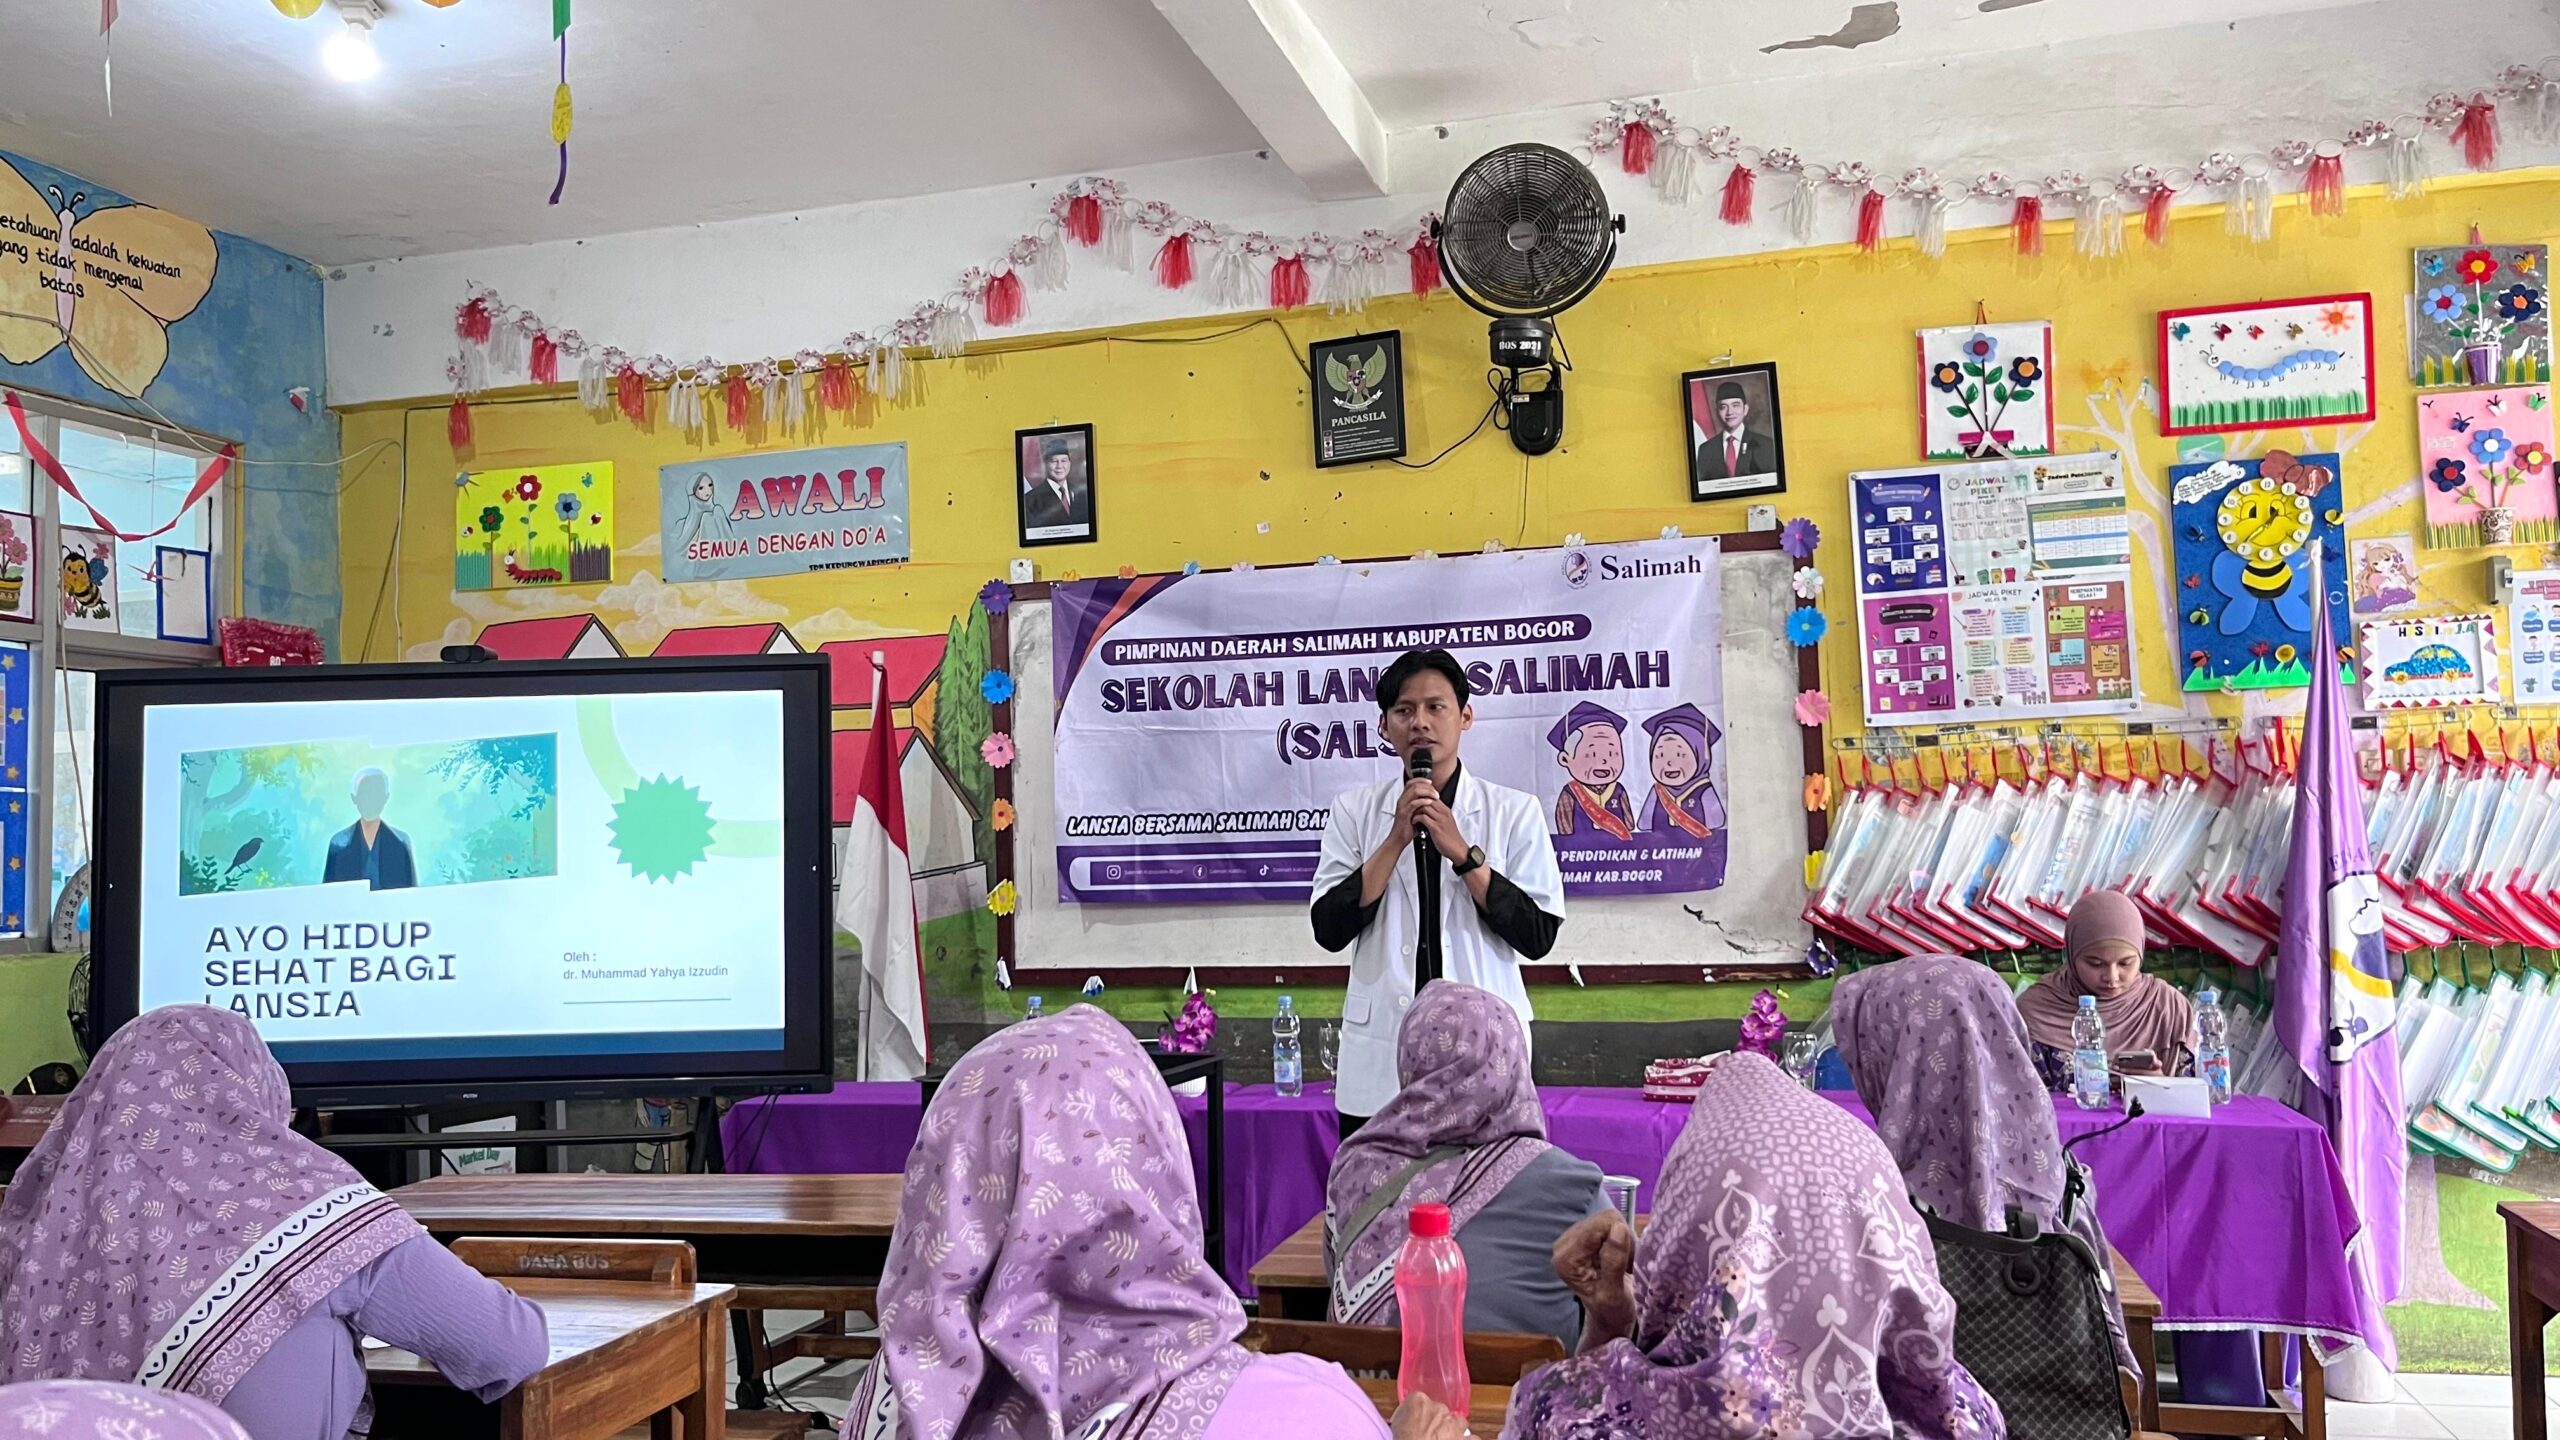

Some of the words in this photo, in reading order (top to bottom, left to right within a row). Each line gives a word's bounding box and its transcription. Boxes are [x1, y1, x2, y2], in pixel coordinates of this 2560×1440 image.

[36, 247, 77, 272] tidak
[84, 261, 144, 291] mengenal
[72, 234, 120, 262] adalah
[127, 249, 181, 278] kekuatan
[40, 270, 85, 298] batas
[1498, 340, 1517, 350] BOS
[1519, 340, 1542, 351] 2021
[1331, 410, 1387, 427] PANCASILA
[729, 466, 886, 522] AWALI
[1965, 475, 2008, 487] JADWAL
[687, 538, 750, 561] SEMUA
[758, 529, 835, 556] DENGAN
[842, 526, 887, 547] DO'A
[1600, 554, 1701, 581] Salimah
[1114, 640, 1205, 661] PIMPINAN
[1210, 636, 1286, 656] DAERAH
[1292, 631, 1377, 653] SALIMAH
[1382, 625, 1498, 649] KABUPATEN
[1504, 619, 1576, 641] BOGOR
[1100, 670, 1285, 714] SEKOLAH
[1298, 664, 1391, 705] LAN
[1464, 649, 1671, 697] SALIMAH
[1067, 816, 1130, 837] LANSIA
[1132, 813, 1215, 836] BERSAMA
[1215, 810, 1296, 833] SALIMAH
[1560, 850, 1637, 863] PENDIDIKAN
[1640, 849, 1649, 861] &
[1652, 847, 1703, 860] LATIHAN
[1594, 869, 1663, 884] KAB.BOGOR
[205, 925, 290, 953] AYO
[303, 921, 432, 951] HIDUP
[204, 957, 337, 987] SEHAT
[350, 953, 457, 983] BAGI
[563, 952, 590, 962] Oleh
[563, 969, 578, 980] dr.
[581, 968, 647, 979] Muhammad
[650, 966, 686, 980] Yahya
[689, 965, 729, 977] Izzudin
[1345, 1368, 1391, 1380] ANA
